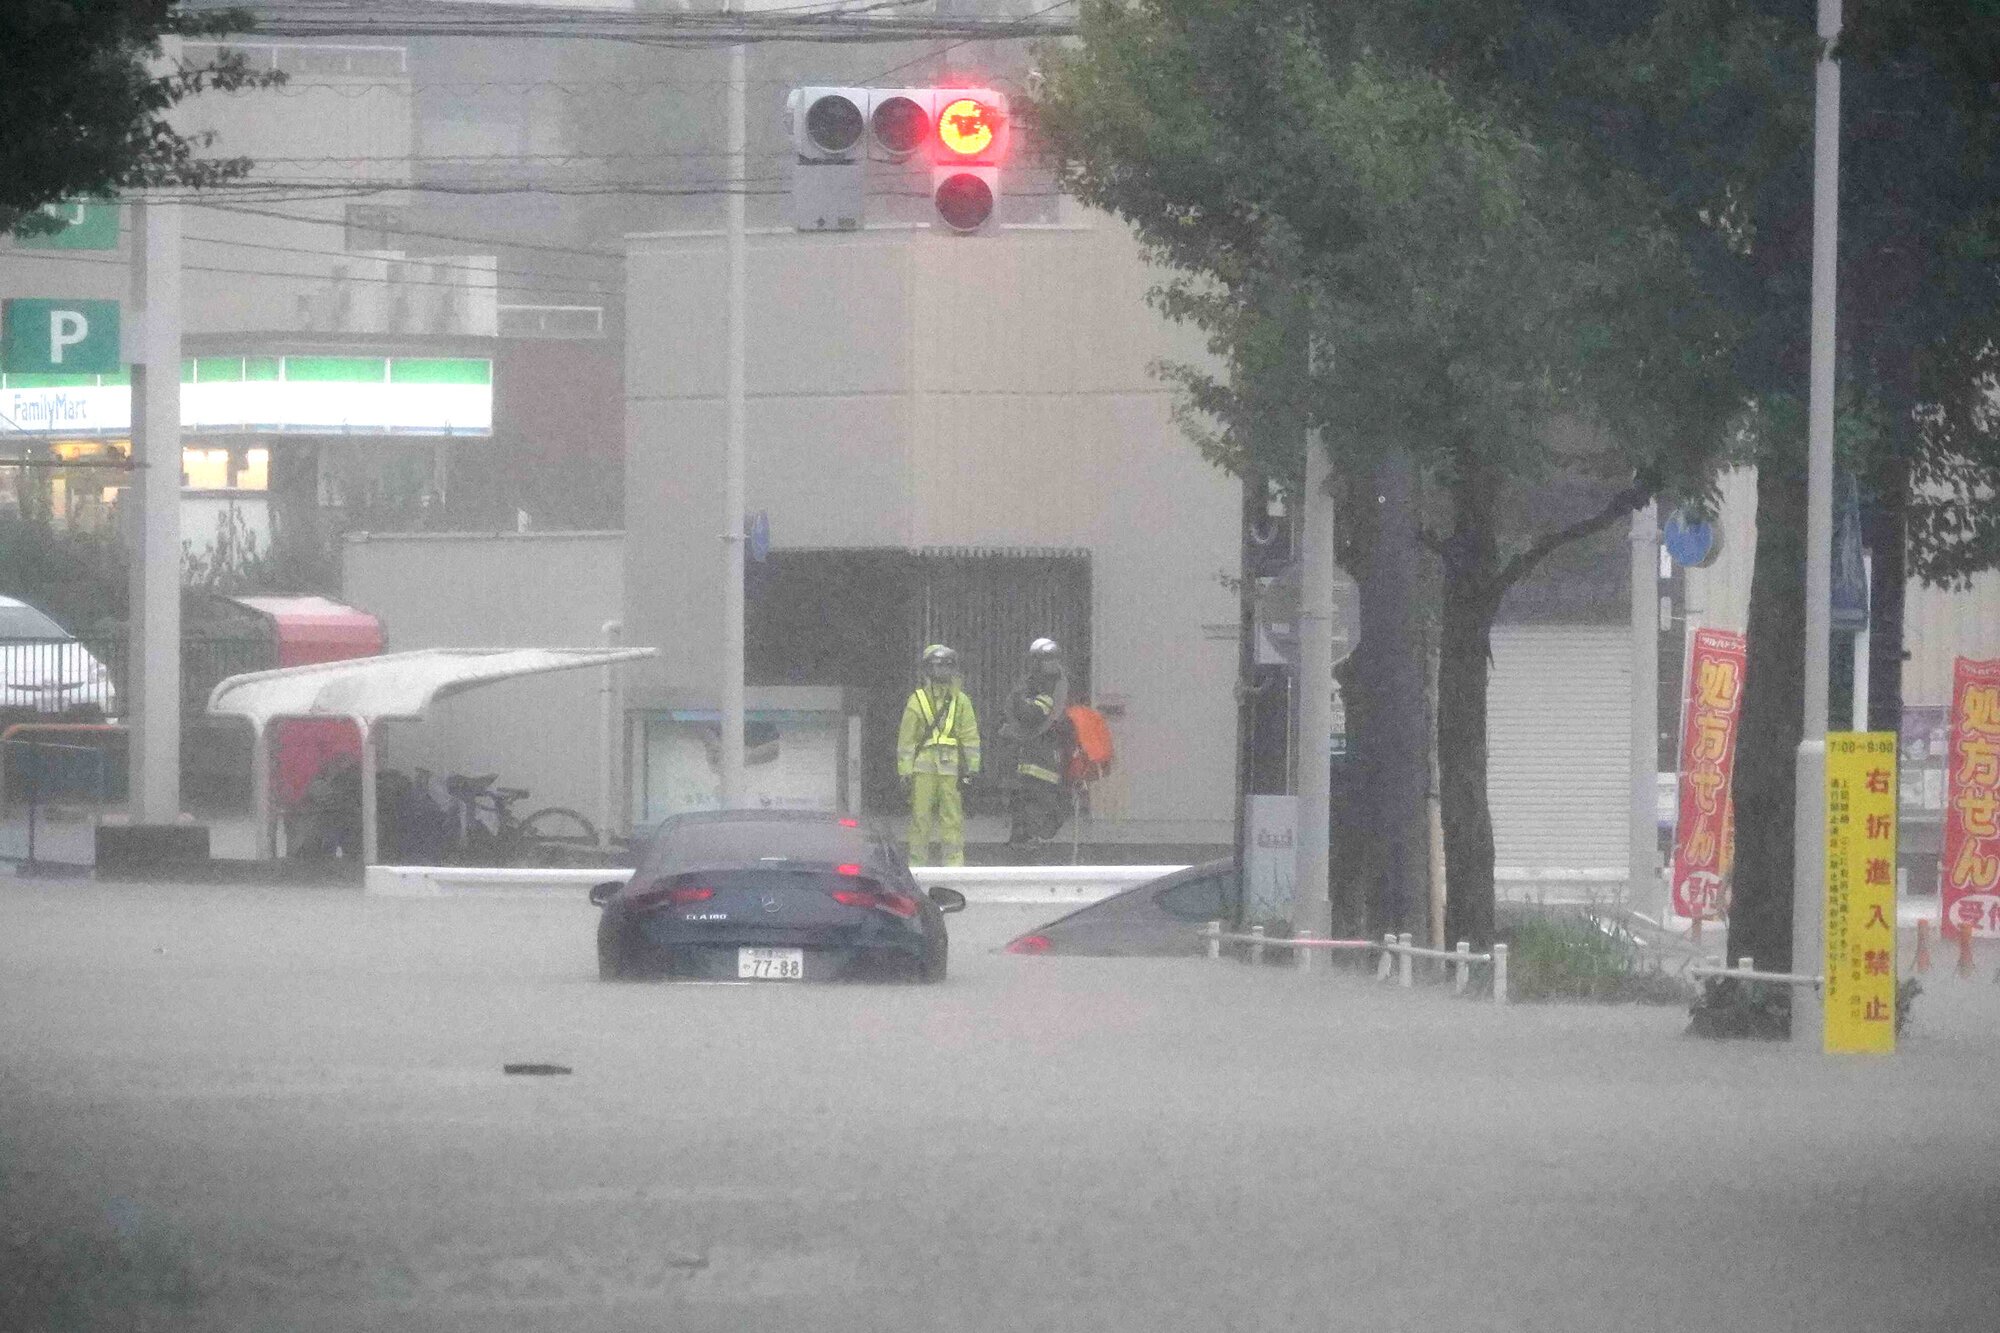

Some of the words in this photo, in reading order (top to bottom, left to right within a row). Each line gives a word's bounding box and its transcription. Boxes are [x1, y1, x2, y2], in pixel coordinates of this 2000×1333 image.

[50, 310, 89, 364] P
[14, 393, 87, 427] FamilyMart
[1686, 656, 1738, 864] 処方せん
[1952, 684, 2000, 888] 処方せん
[754, 959, 800, 976] 77-88
